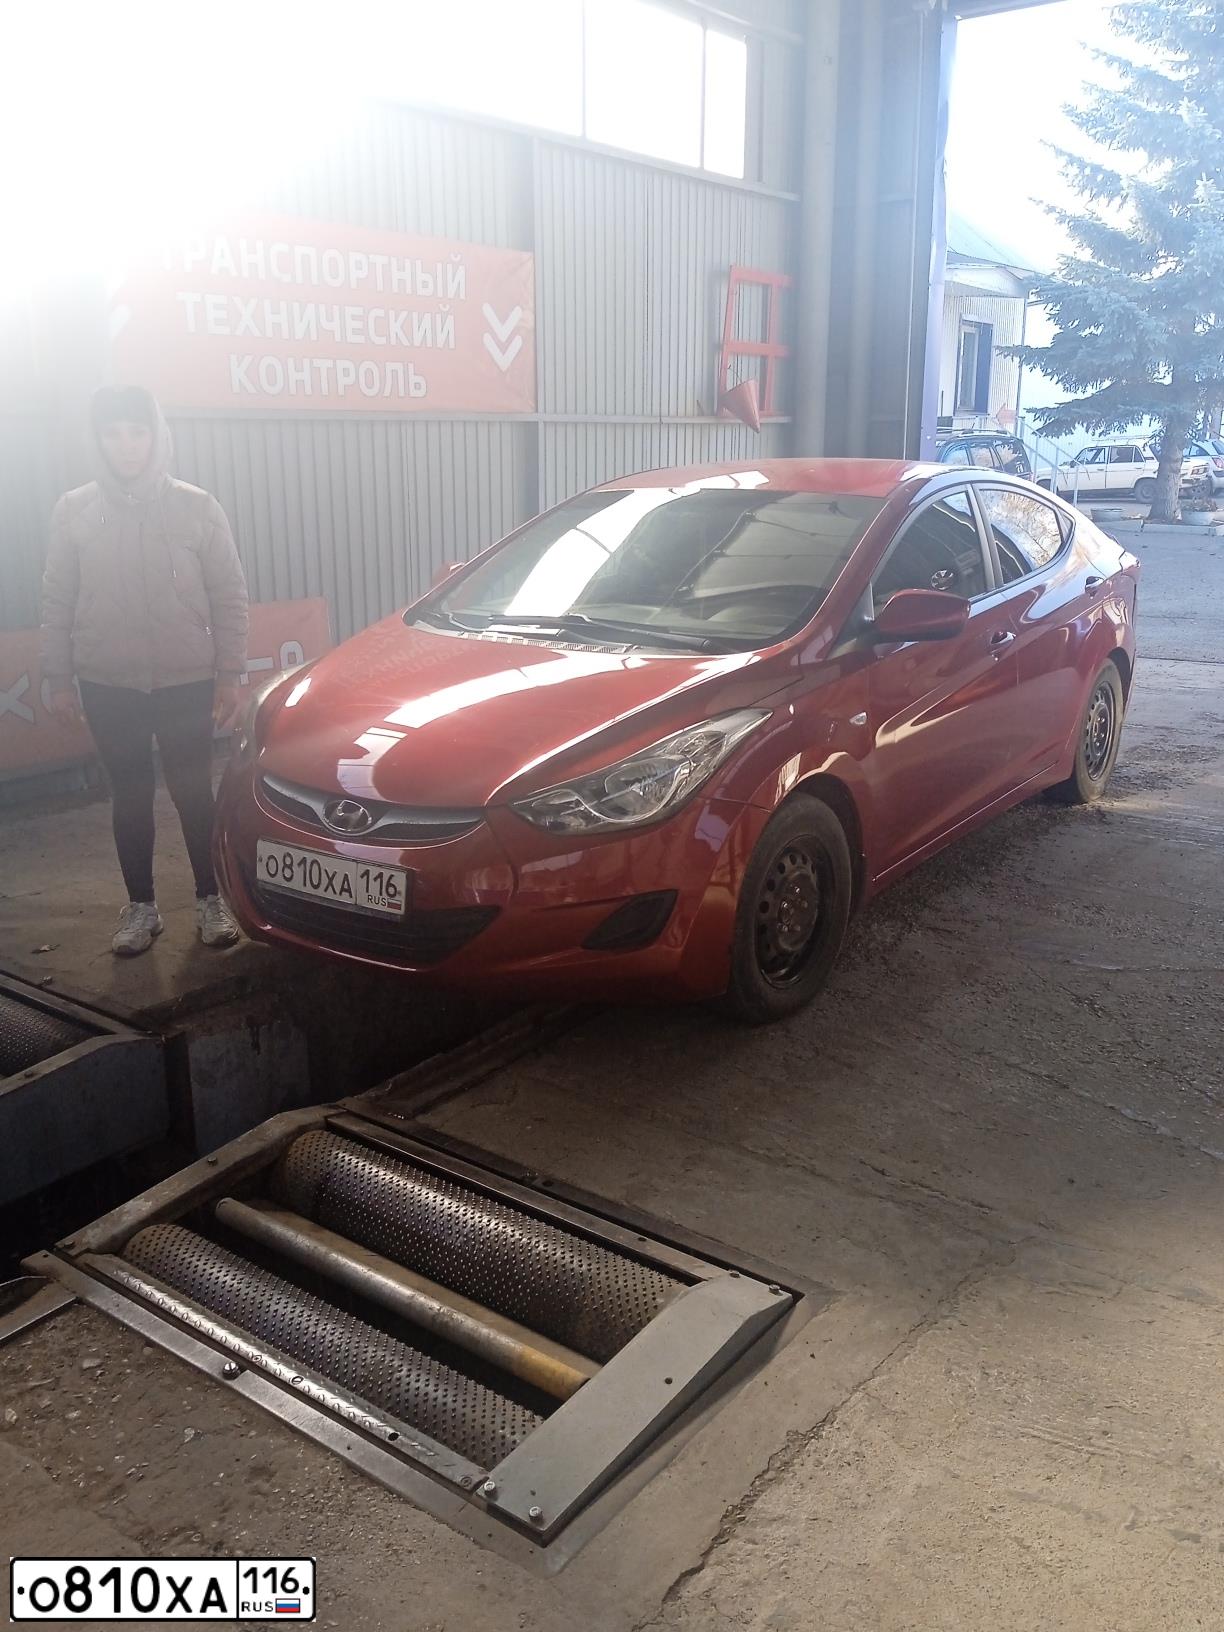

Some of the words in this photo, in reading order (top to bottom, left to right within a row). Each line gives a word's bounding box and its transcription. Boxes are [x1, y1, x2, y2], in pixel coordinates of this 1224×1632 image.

[175, 291, 456, 349] ТЕХНИЧЕСКИЙ
[229, 353, 428, 398] КОНТРОЛЬ
[265, 852, 354, 898] О810ХА
[360, 868, 398, 898] 116
[367, 894, 388, 907] RUS
